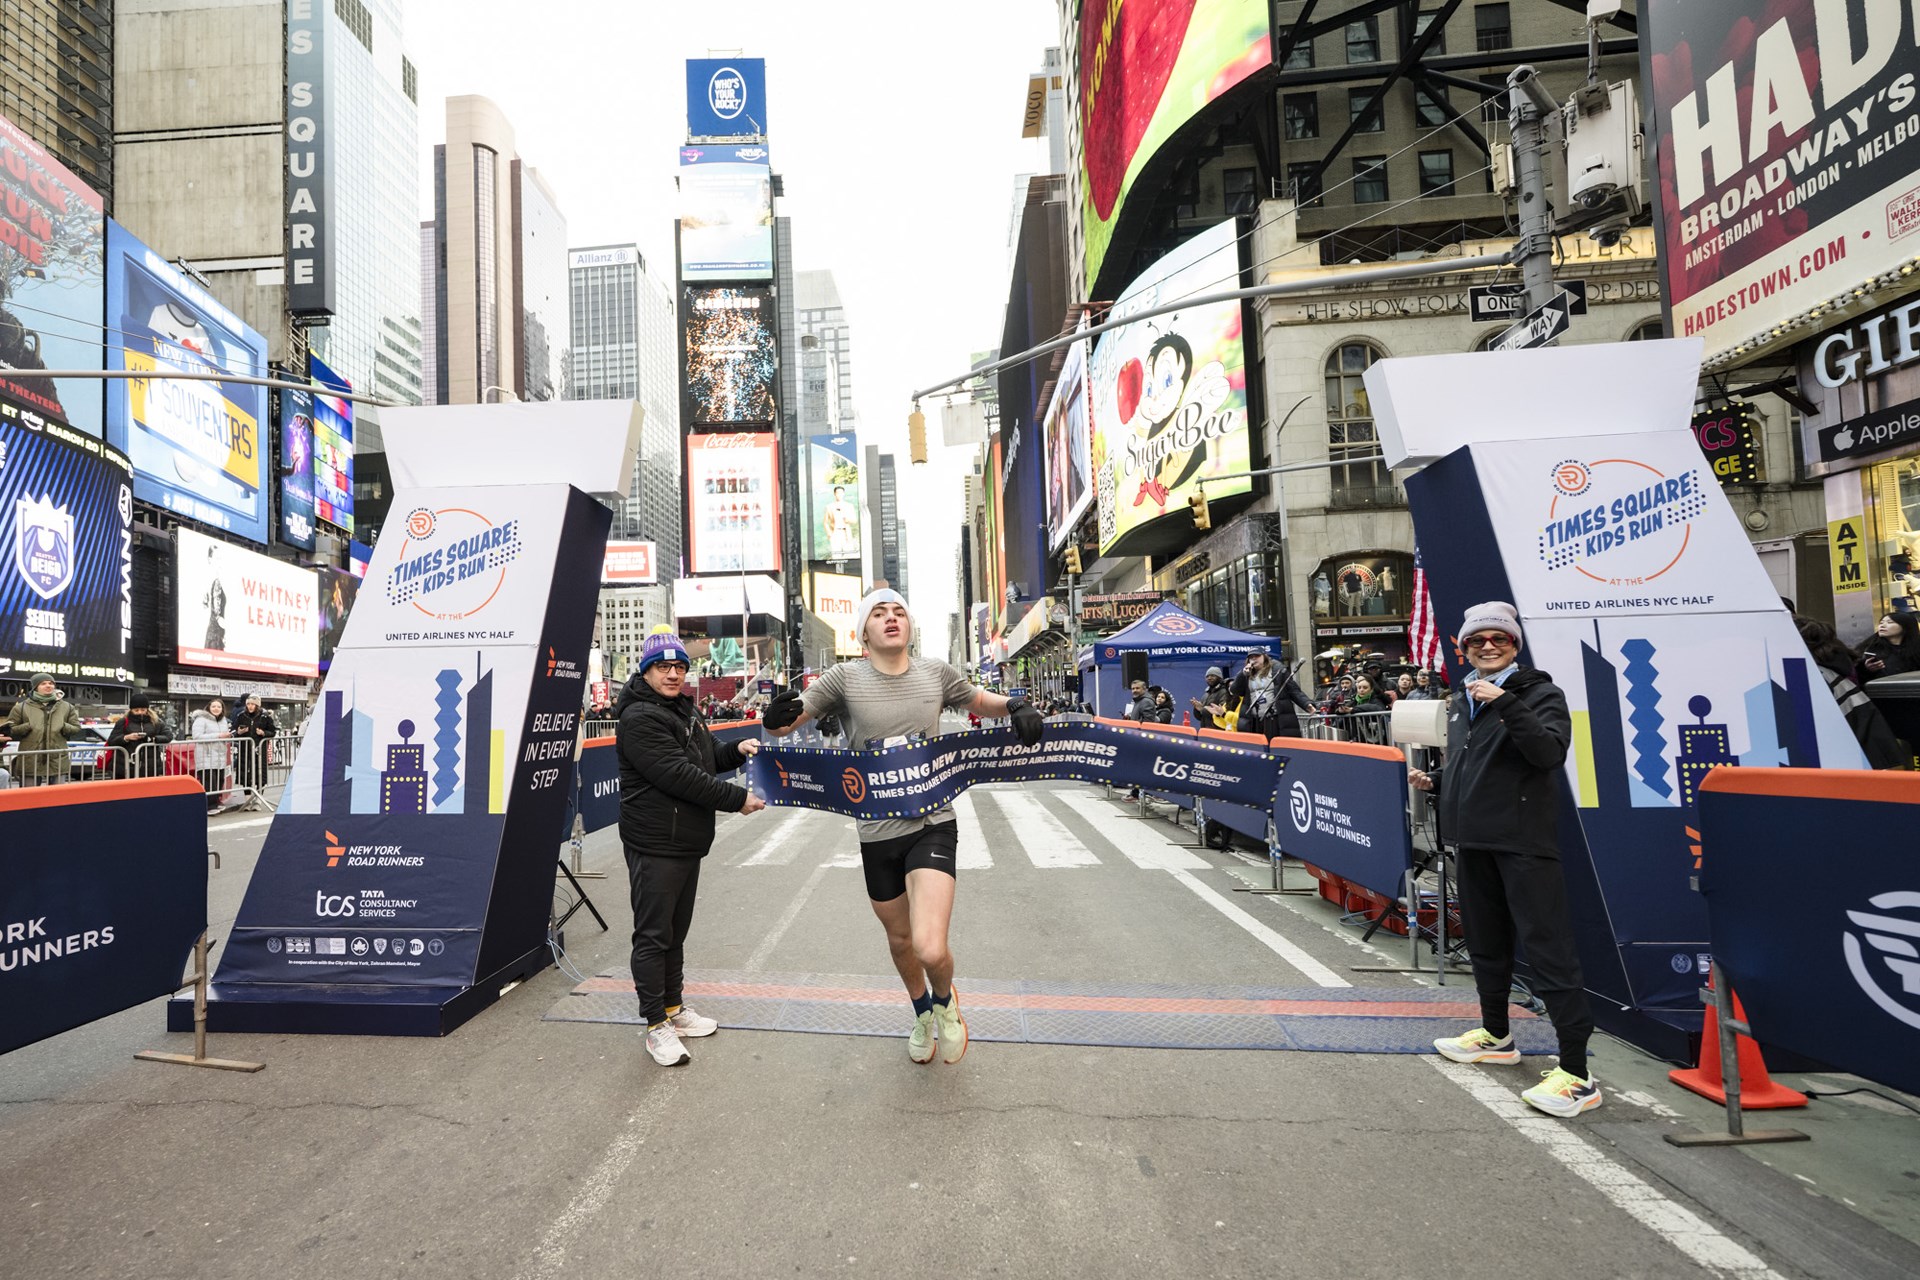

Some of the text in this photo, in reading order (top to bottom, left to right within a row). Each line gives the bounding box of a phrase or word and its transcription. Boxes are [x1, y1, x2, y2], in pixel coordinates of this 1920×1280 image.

[714, 78, 740, 90] WHO'S
[714, 89, 735, 99] YOUR
[1671, 0, 1920, 211] HAD
[1680, 72, 1916, 246] BROADWAY'S
[0, 147, 67, 214] UCK
[288, 82, 317, 285] SQUARE
[0, 189, 52, 242] UN
[1685, 213, 1763, 271] AMSTERDAM
[1778, 162, 1841, 216] LONDON
[576, 252, 613, 265] Allianz
[1684, 235, 1848, 338] HADESTOWN.COM
[1301, 303, 1340, 320] THE
[1348, 298, 1407, 316] SHOW
[1487, 296, 1520, 311] ONE
[1530, 311, 1556, 339] WAY
[152, 335, 187, 367] NEW
[8, 382, 62, 414] THEATERS
[2, 403, 100, 453] ET MARCH 20
[160, 377, 252, 460] SOUVENIRS
[1858, 412, 1920, 446] Apple
[703, 432, 758, 449] Coca-Cola
[1125, 401, 1233, 481] Sugar Bee
[1545, 471, 1692, 548] TIMES SQUARE
[1586, 510, 1663, 558] KIDS RUN
[394, 521, 512, 586] TIMES SQUARE
[423, 554, 486, 594] KIDS RUN
[1175, 551, 1211, 584] EXPRESS
[41, 576, 52, 585] FC
[1624, 577, 1644, 586] THE
[1836, 581, 1866, 591] INSIDE
[241, 576, 311, 612] WHITNEY
[1545, 595, 1714, 611] UNITED AIRLINES NYC HALF
[26, 608, 64, 630] SEATTLE
[248, 605, 307, 634] LEAVITT
[437, 612, 463, 621] AT THE
[1081, 606, 1103, 620] IFTS
[385, 630, 515, 642] UNITED AIRLINES NYC HALF
[1152, 645, 1226, 656] NEW YORK ROAD
[15, 661, 57, 674] MARCH
[57, 664, 73, 675] 20
[555, 670, 582, 680] ROAD RUNNERS
[556, 660, 576, 671] NEW YORK
[594, 683, 605, 705] tkts
[532, 713, 575, 733] BELIEVE
[524, 739, 573, 762] IN EVERY
[867, 739, 1119, 786] RISING NEW YORK ROAD RUNNERS
[1152, 755, 1189, 781] tcs
[1193, 762, 1215, 772] TATA
[530, 768, 560, 790] STEP
[788, 772, 812, 783] NEW YORK
[791, 780, 825, 793] ROAD RUNNERS
[871, 754, 1115, 799] TIMES SQUARE KIDS RUN AT THE UNITED AIRLINES NYC HALF
[1188, 776, 1222, 788] SERVICES
[1191, 769, 1242, 784] CONSULTANCY
[1314, 793, 1338, 809] RISING
[1315, 806, 1352, 827] NEW YORK
[1316, 819, 1372, 848] ROAD RUNNERS
[347, 856, 425, 867] ROAD RUNNERS
[348, 845, 402, 856] NEW YORK
[316, 889, 356, 917] tcs
[359, 899, 418, 909] CONSULTANCY
[360, 890, 385, 898] TATA
[359, 909, 396, 917] SERVICES
[0, 916, 46, 944] RK
[409, 941, 422, 951] MTA
